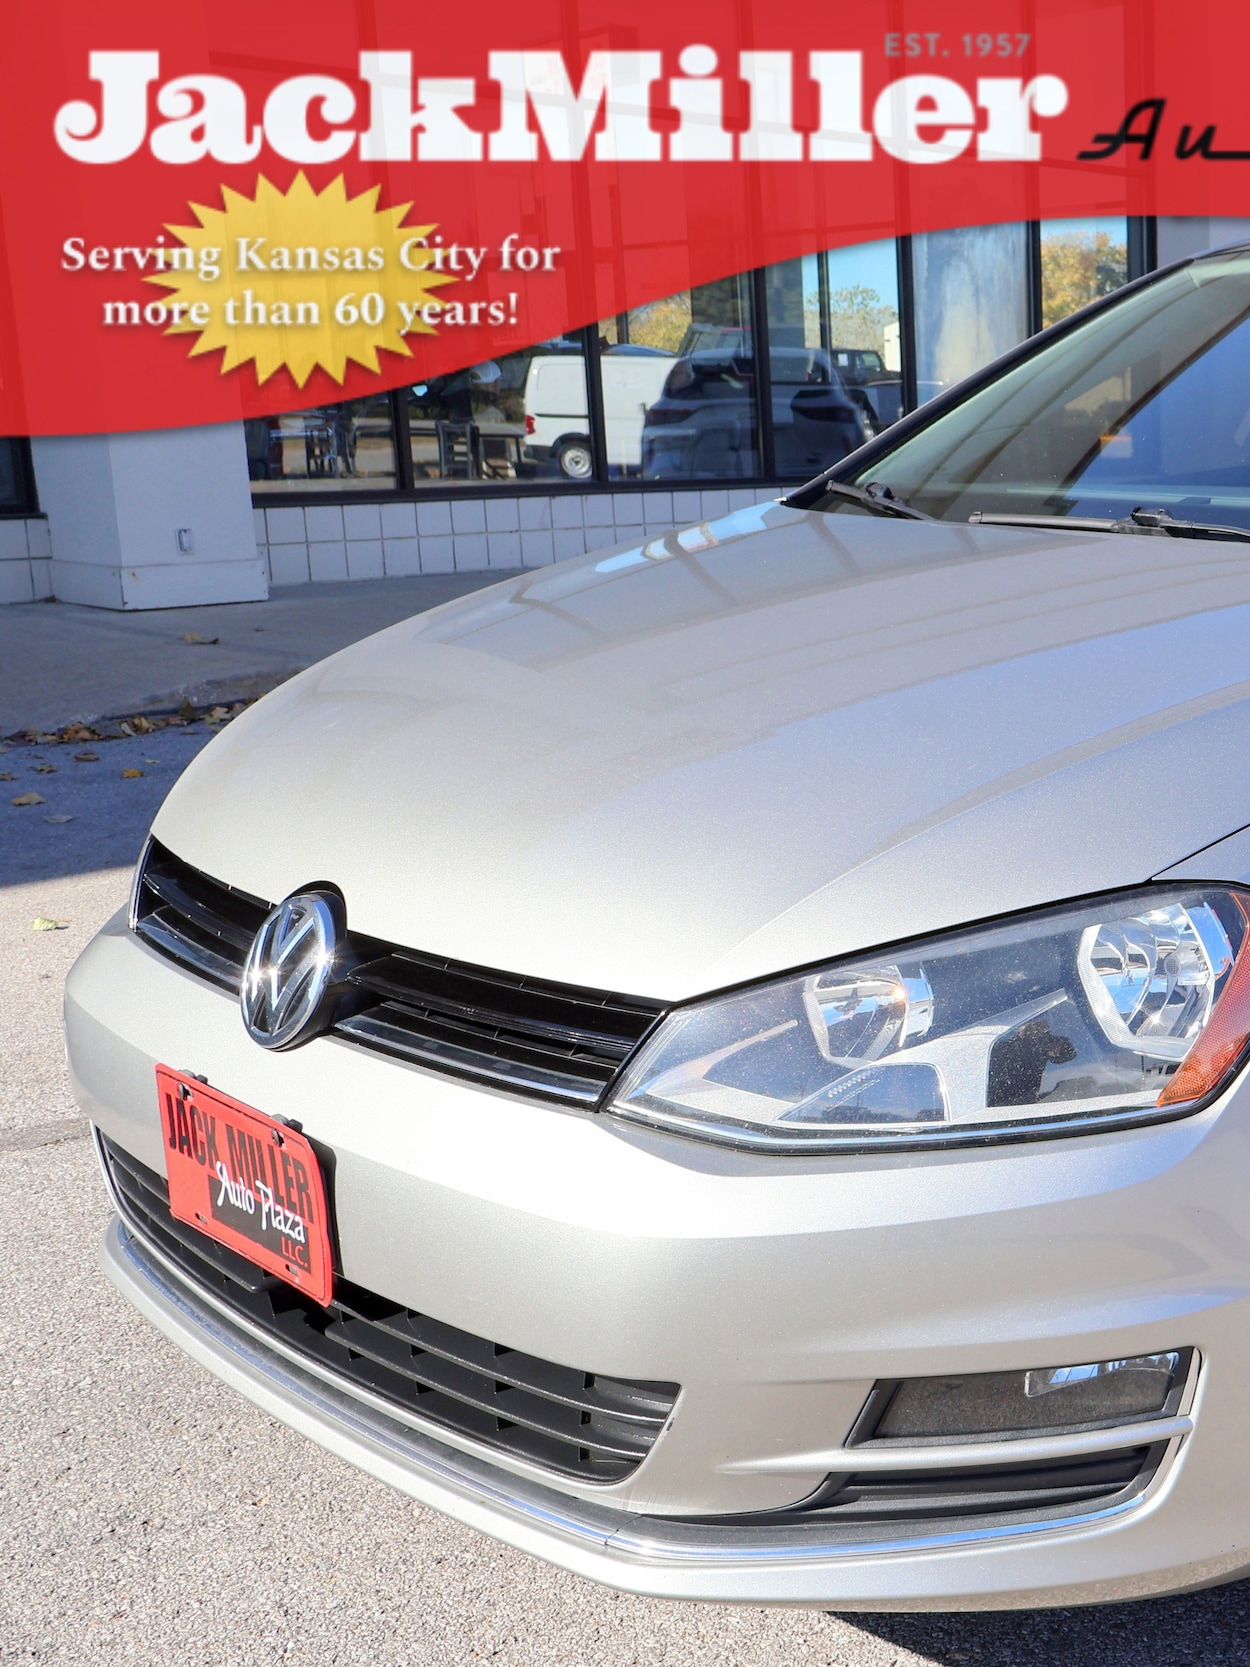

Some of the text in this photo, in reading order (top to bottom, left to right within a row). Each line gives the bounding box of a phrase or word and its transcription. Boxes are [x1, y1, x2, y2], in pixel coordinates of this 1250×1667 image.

[165, 1092, 314, 1224] JACK MILLER
[216, 1160, 306, 1244] Auto Plaza
